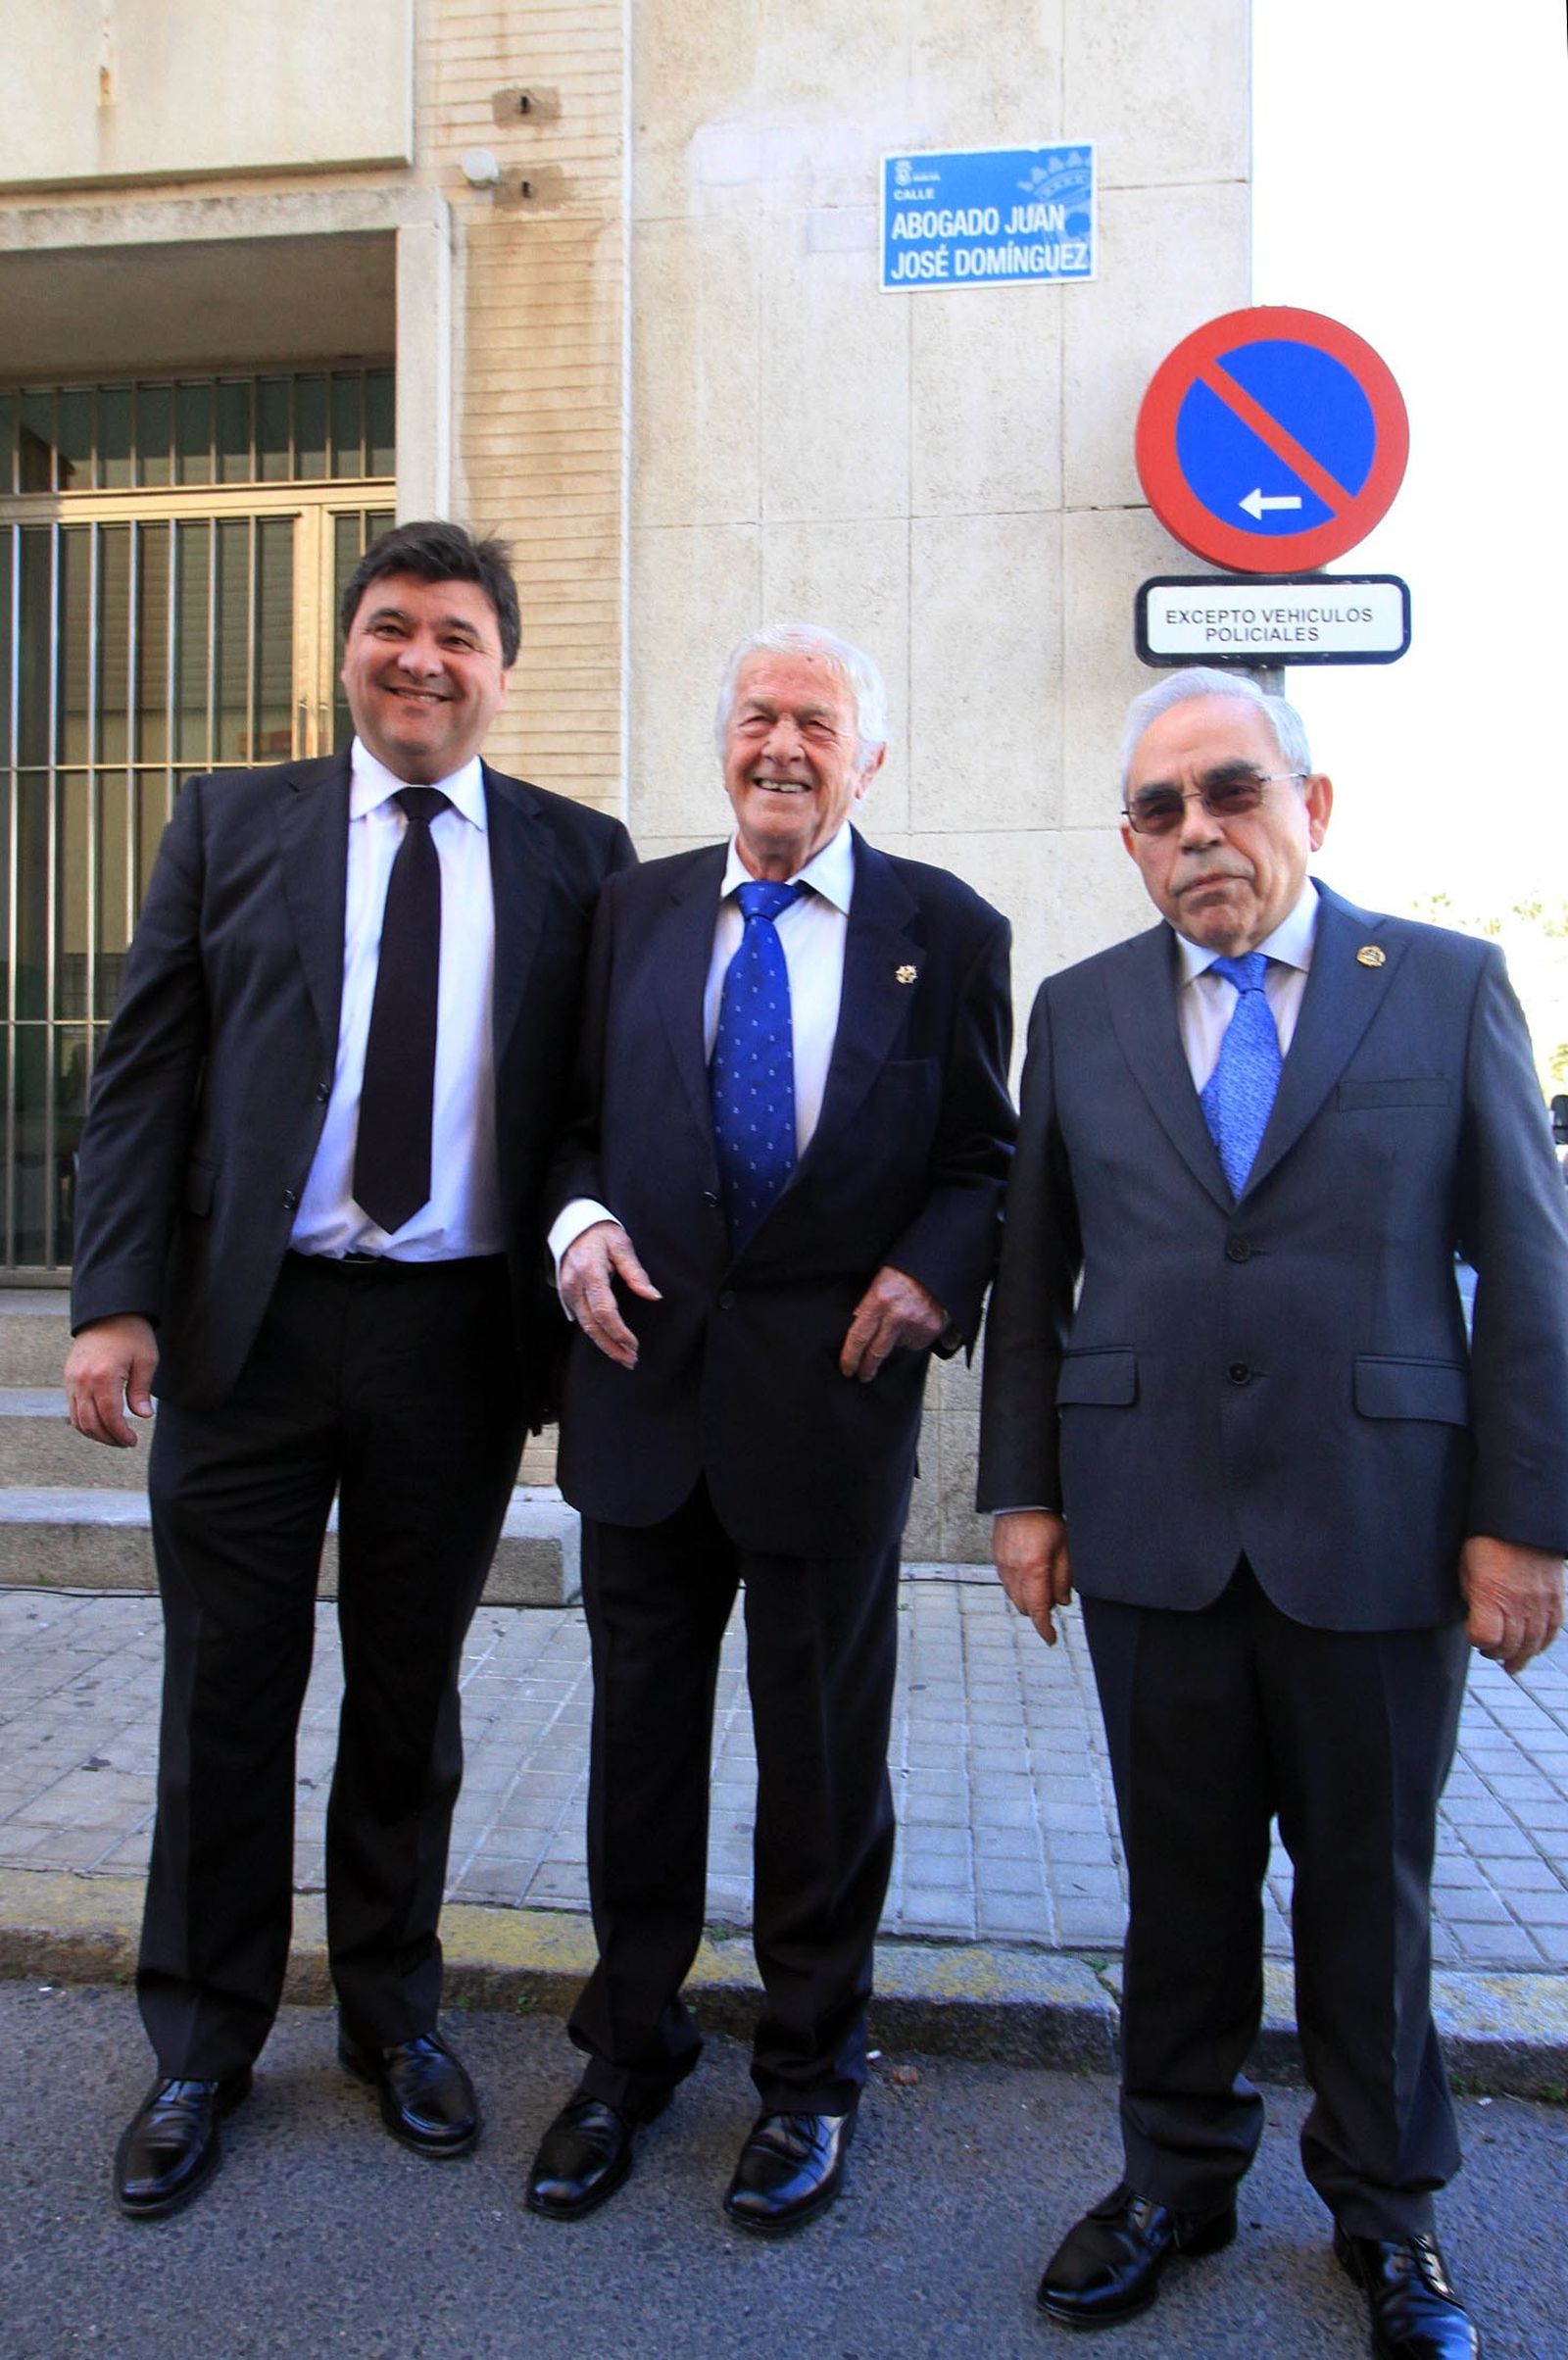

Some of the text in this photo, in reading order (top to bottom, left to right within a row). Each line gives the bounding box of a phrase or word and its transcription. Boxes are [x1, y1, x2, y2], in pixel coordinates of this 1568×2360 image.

[893, 187, 935, 202] CALLE
[891, 204, 1065, 240] ABOGADO JUAN
[891, 240, 1088, 279] JOSÉ DOMÍNGUEZ
[1166, 608, 1373, 624] EXCEPTO VEHICULOS
[1205, 626, 1320, 642] POLICIALES
